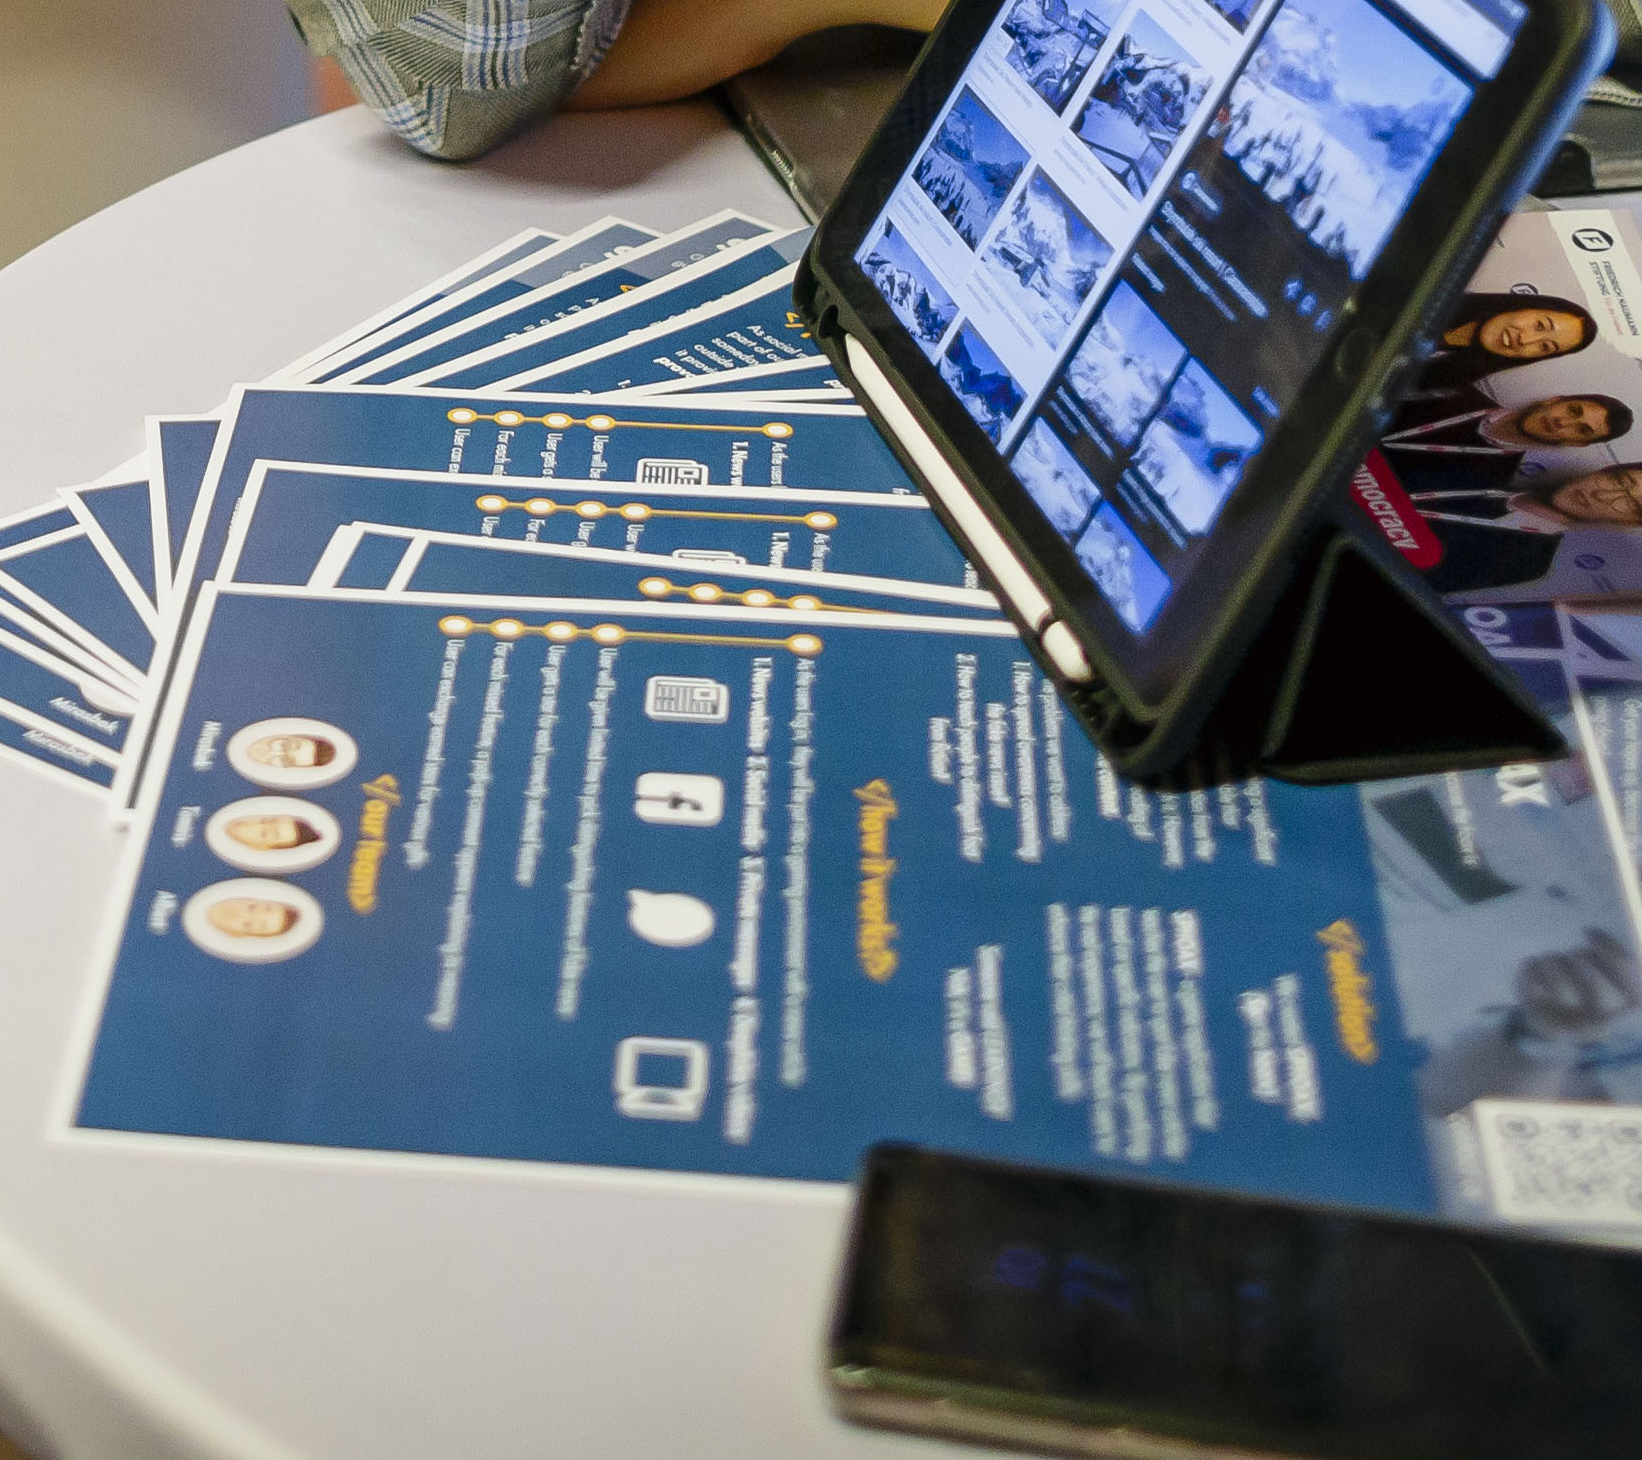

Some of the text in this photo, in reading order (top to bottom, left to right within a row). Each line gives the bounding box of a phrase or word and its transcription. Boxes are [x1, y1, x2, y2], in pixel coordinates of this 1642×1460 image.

[726, 331, 770, 357] part of
[747, 325, 764, 336] As
[763, 333, 800, 354] social
[694, 344, 736, 369] outside
[450, 428, 470, 462] User can
[494, 430, 514, 463] For each
[546, 432, 562, 450] User
[541, 451, 556, 467] gets
[589, 434, 608, 479] User will be
[730, 441, 748, 476] 1. News
[770, 441, 787, 484] As the users
[1354, 463, 1420, 549] mocracy
[477, 516, 498, 536] User
[527, 519, 545, 532] For
[577, 521, 595, 540] User
[625, 524, 643, 543] User
[772, 531, 789, 541] 1.
[812, 532, 829, 557] As the
[444, 639, 464, 660] User
[493, 641, 513, 656] For
[547, 645, 566, 666] User
[598, 648, 617, 669] User
[441, 660, 457, 678] can
[489, 657, 508, 680] each
[753, 657, 772, 667] 1.
[796, 658, 814, 670] As
[540, 666, 559, 686] gets
[596, 670, 615, 687] will
[750, 668, 772, 699] News
[795, 671, 815, 686] the
[956, 665, 976, 687] How
[1013, 671, 1032, 693] How
[428, 679, 455, 725] exchange
[594, 687, 615, 700] be
[794, 686, 811, 710] users
[957, 688, 973, 699] to
[1014, 694, 1030, 704] to
[588, 700, 609, 727] given
[789, 711, 813, 727] log
[957, 700, 978, 726] teach
[986, 703, 1005, 718] the
[1038, 693, 1063, 737] problems
[747, 700, 769, 751] websites
[987, 719, 1007, 741] fake
[1010, 706, 1035, 740] spread
[954, 727, 978, 763] people
[987, 743, 1004, 768] news
[959, 764, 977, 776] to
[1016, 741, 1035, 796] awareness
